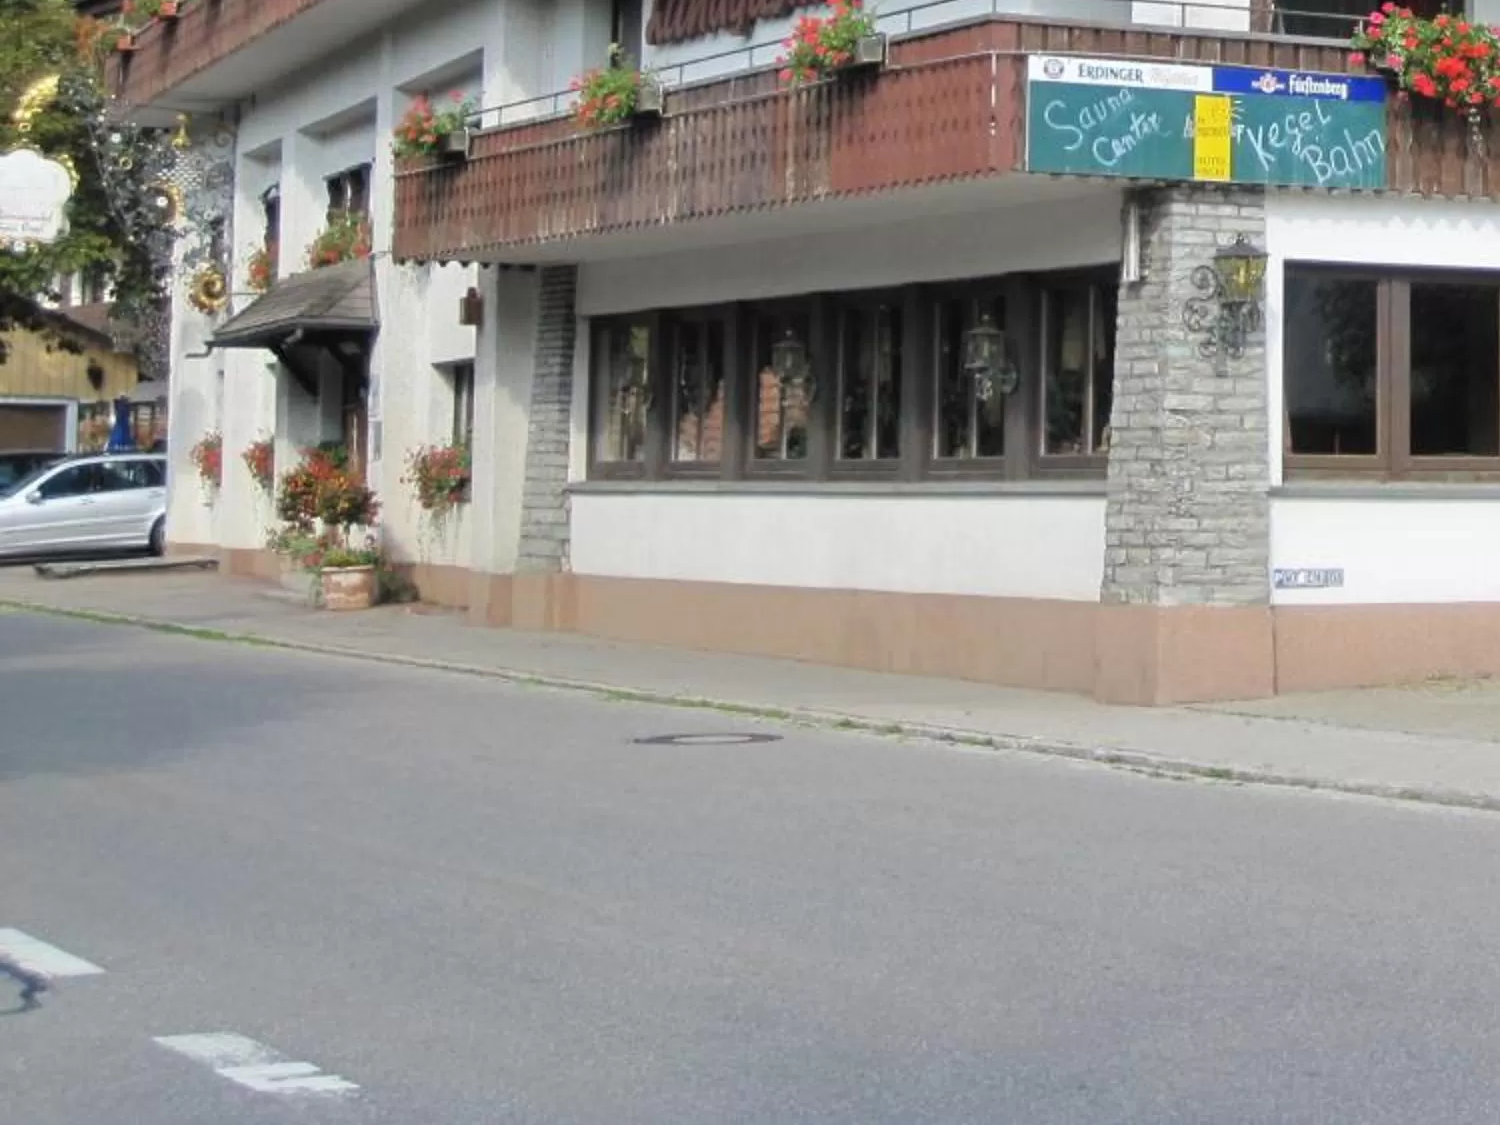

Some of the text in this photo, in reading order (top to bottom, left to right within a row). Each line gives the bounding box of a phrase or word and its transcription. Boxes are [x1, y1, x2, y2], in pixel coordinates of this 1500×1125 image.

[1078, 63, 1144, 83] ERDINGER
[1044, 88, 1134, 151] Sauna
[1246, 99, 1332, 171] Kegel
[1301, 128, 1385, 183] Bahn
